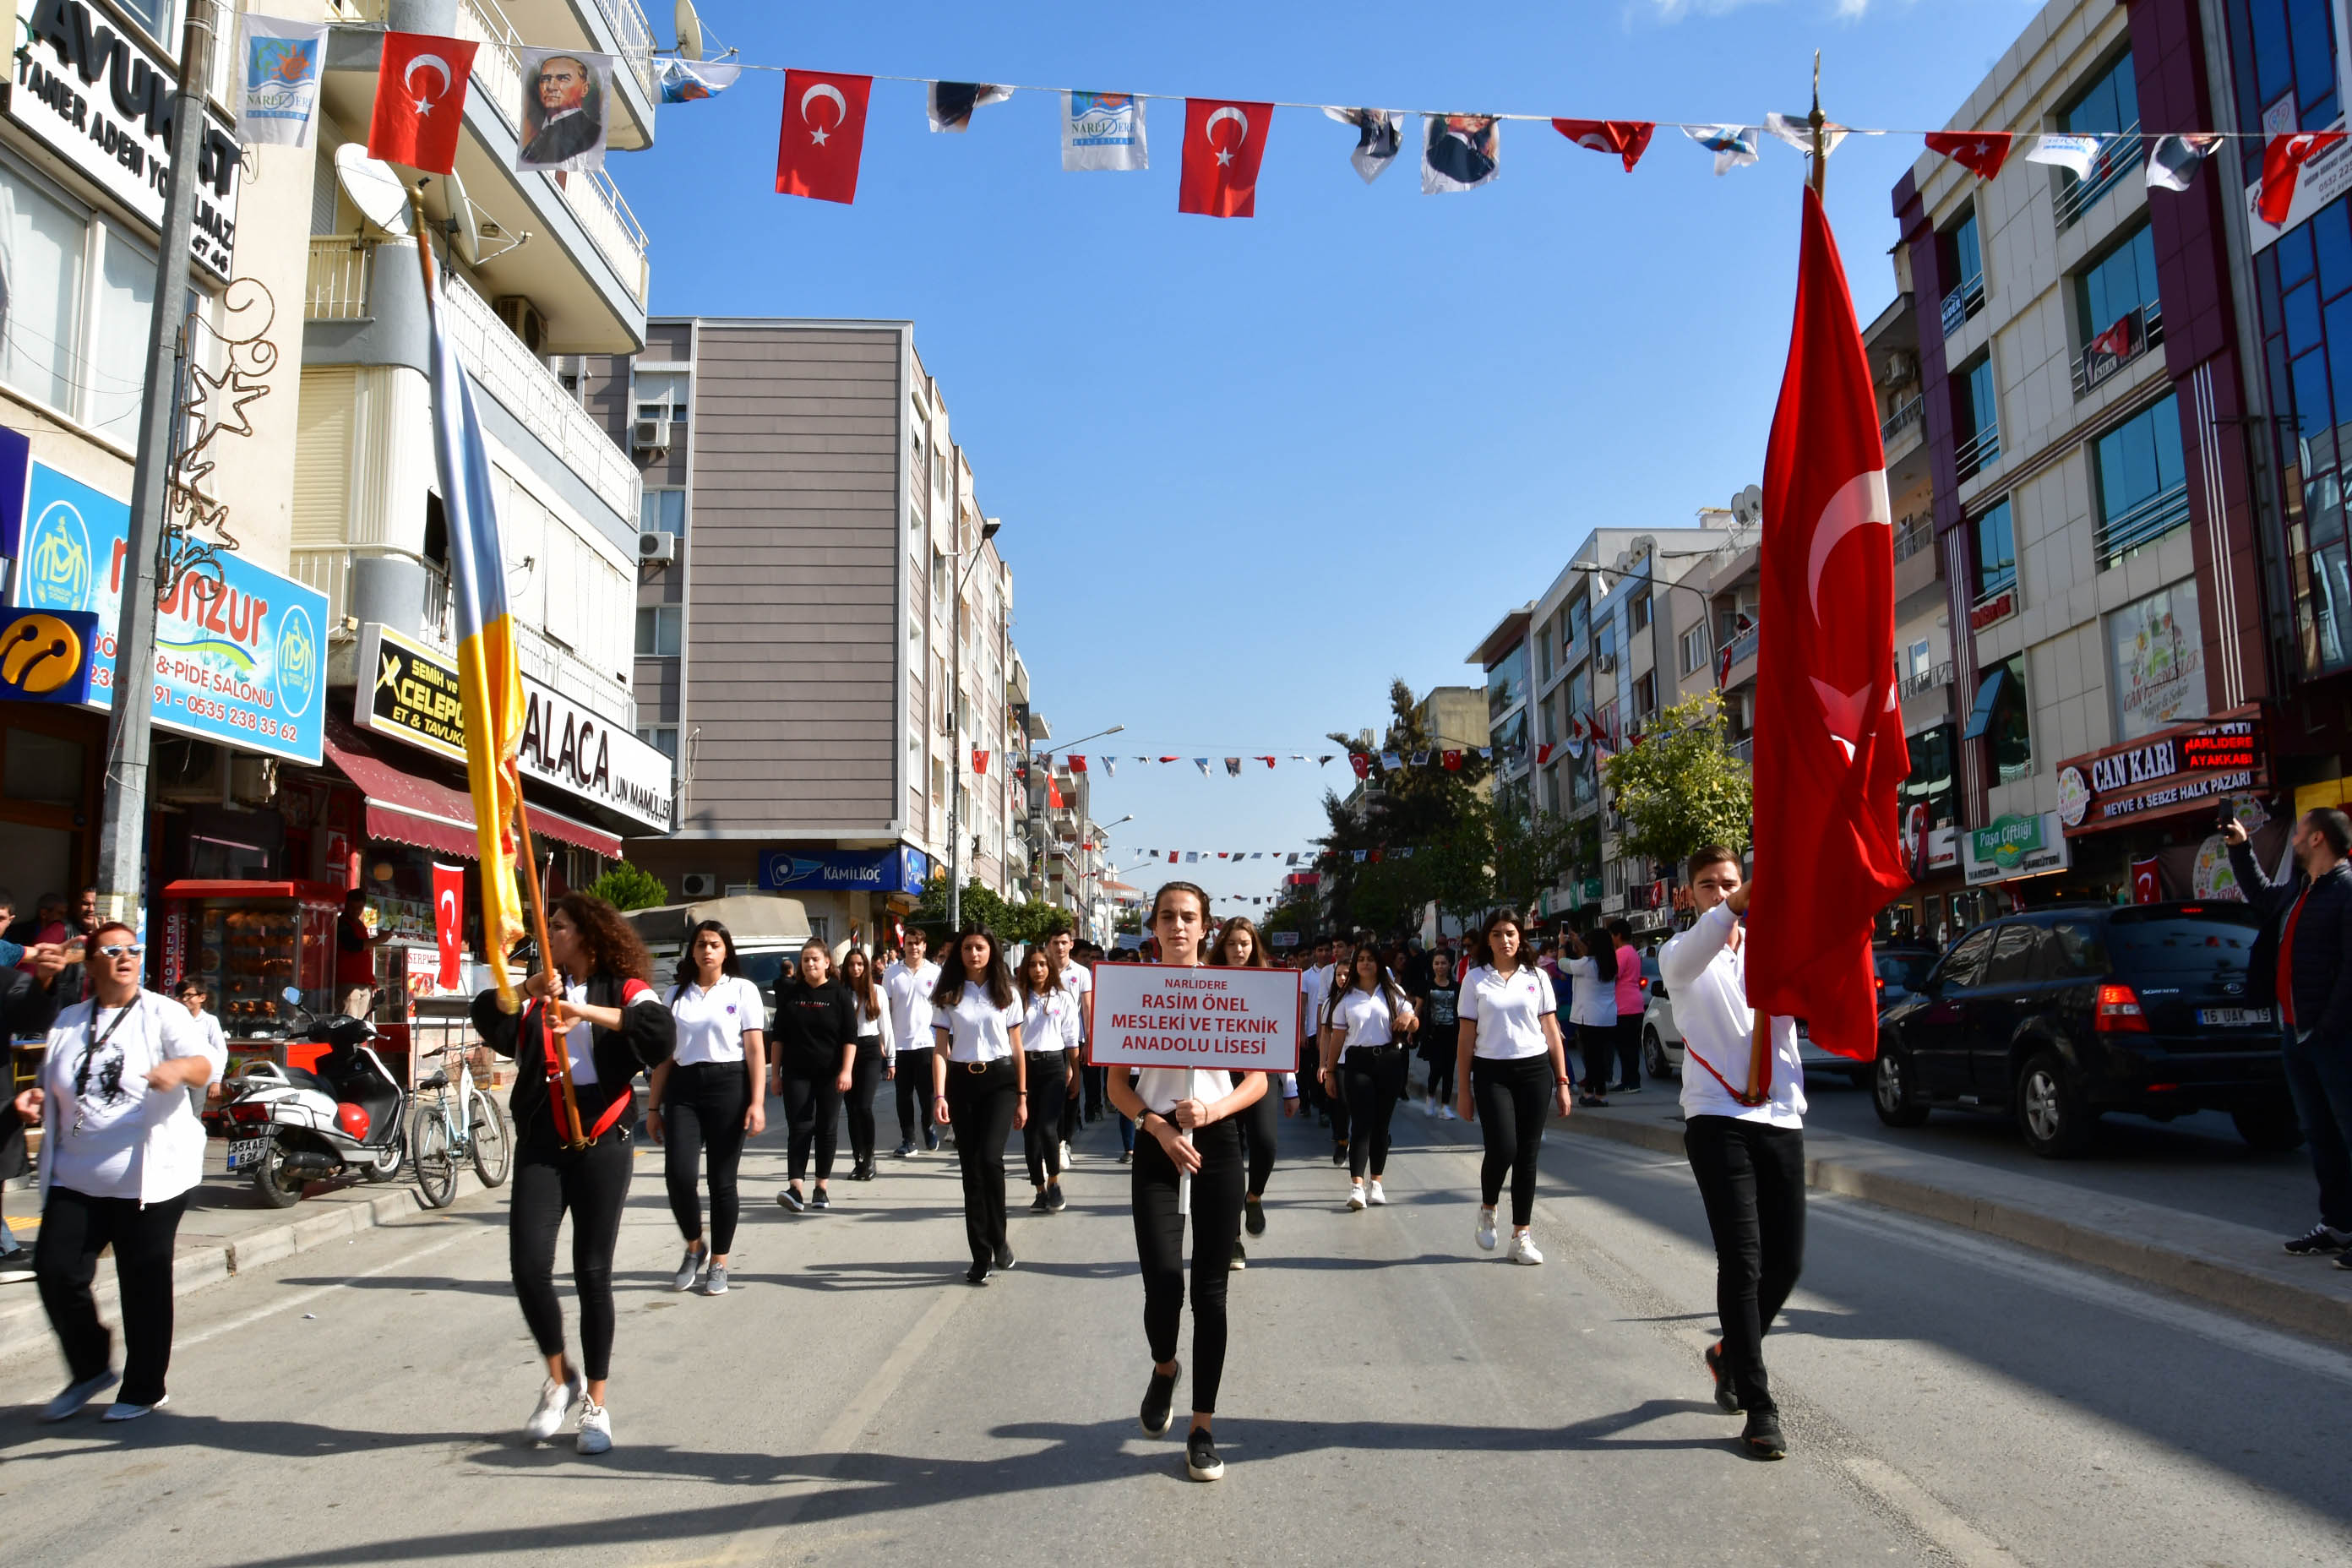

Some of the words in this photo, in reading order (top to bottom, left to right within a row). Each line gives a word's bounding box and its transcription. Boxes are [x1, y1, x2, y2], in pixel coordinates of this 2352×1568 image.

[19, 52, 86, 133] TANER
[90, 111, 144, 177] ADEM
[175, 659, 209, 687] PİDE
[213, 674, 274, 709] SALONU
[411, 659, 444, 688] SEMİH
[188, 695, 225, 721] 0535
[229, 705, 256, 729] 238
[260, 714, 277, 736] 35
[280, 719, 297, 742] 62
[392, 705, 409, 722] ET
[410, 714, 422, 729] &
[520, 691, 609, 794] ALACA
[615, 775, 629, 801] UN
[2092, 754, 2126, 793] CAN
[2103, 798, 2135, 818] MEYVE
[2137, 798, 2144, 810] &
[2146, 791, 2178, 808] SEBZE
[2180, 782, 2208, 801] HALK
[2211, 770, 2251, 792] PAZARI
[1979, 831, 2000, 848] Paşa
[2001, 819, 2032, 844] Çiftliği
[1165, 978, 1228, 990] NARLIDERE
[1142, 993, 1198, 1010] RASİM
[1202, 994, 1249, 1012] ÖNEL
[1112, 1013, 1185, 1031] MESLEKİ
[1190, 1016, 1211, 1032] VE
[1215, 1016, 1278, 1034] TEKNİK
[1121, 1035, 1210, 1053] ANADOLU
[1214, 1037, 1266, 1054] LİSESİ
